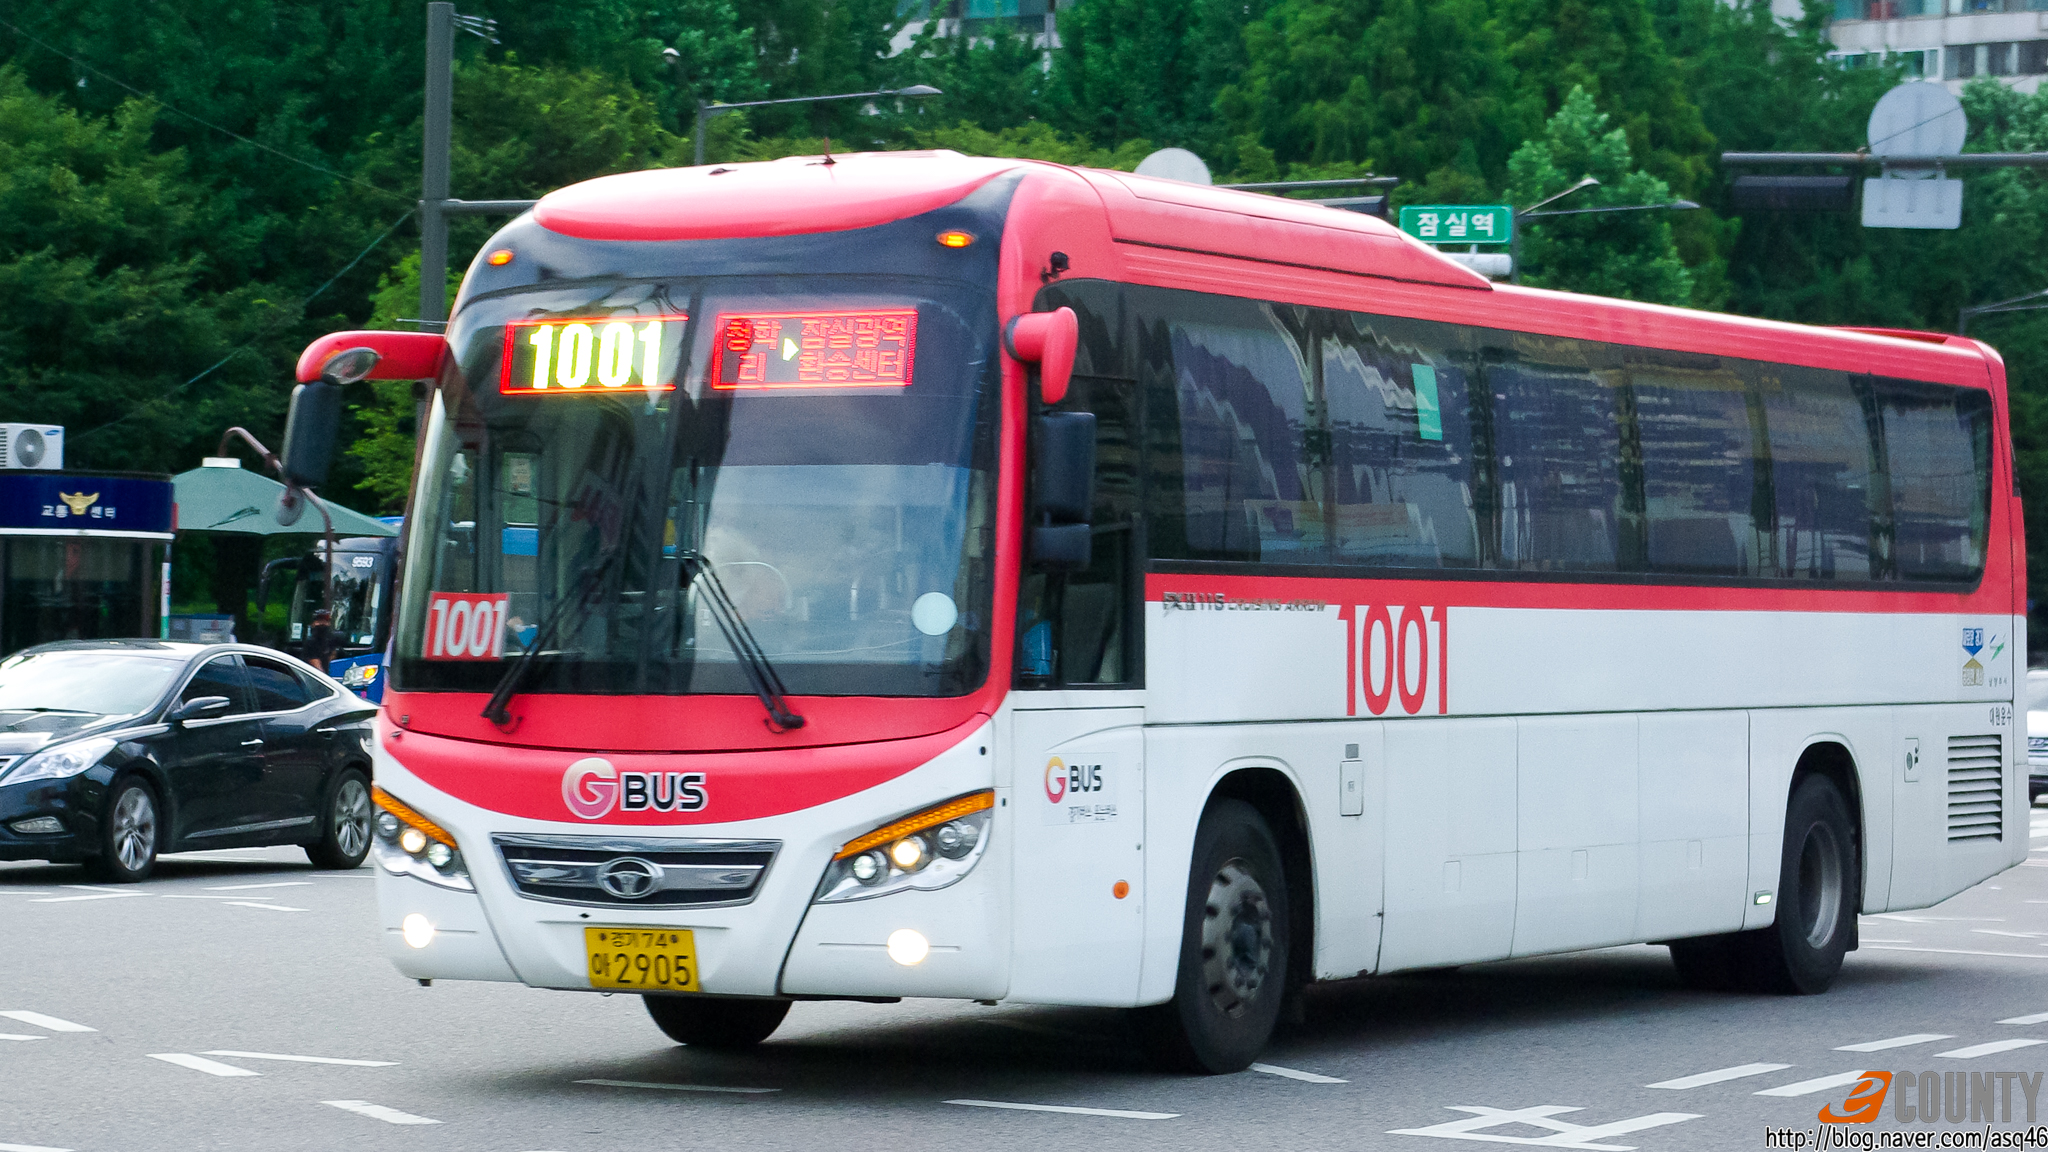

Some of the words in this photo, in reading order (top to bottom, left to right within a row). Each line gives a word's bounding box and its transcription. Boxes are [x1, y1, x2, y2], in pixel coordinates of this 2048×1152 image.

[1417, 212, 1494, 237] 잠실역
[529, 320, 663, 390] 1001
[801, 317, 909, 350] 잠실광역
[798, 349, 906, 382] 환승센터
[432, 599, 507, 658] 1001
[1337, 600, 1448, 716] 1001
